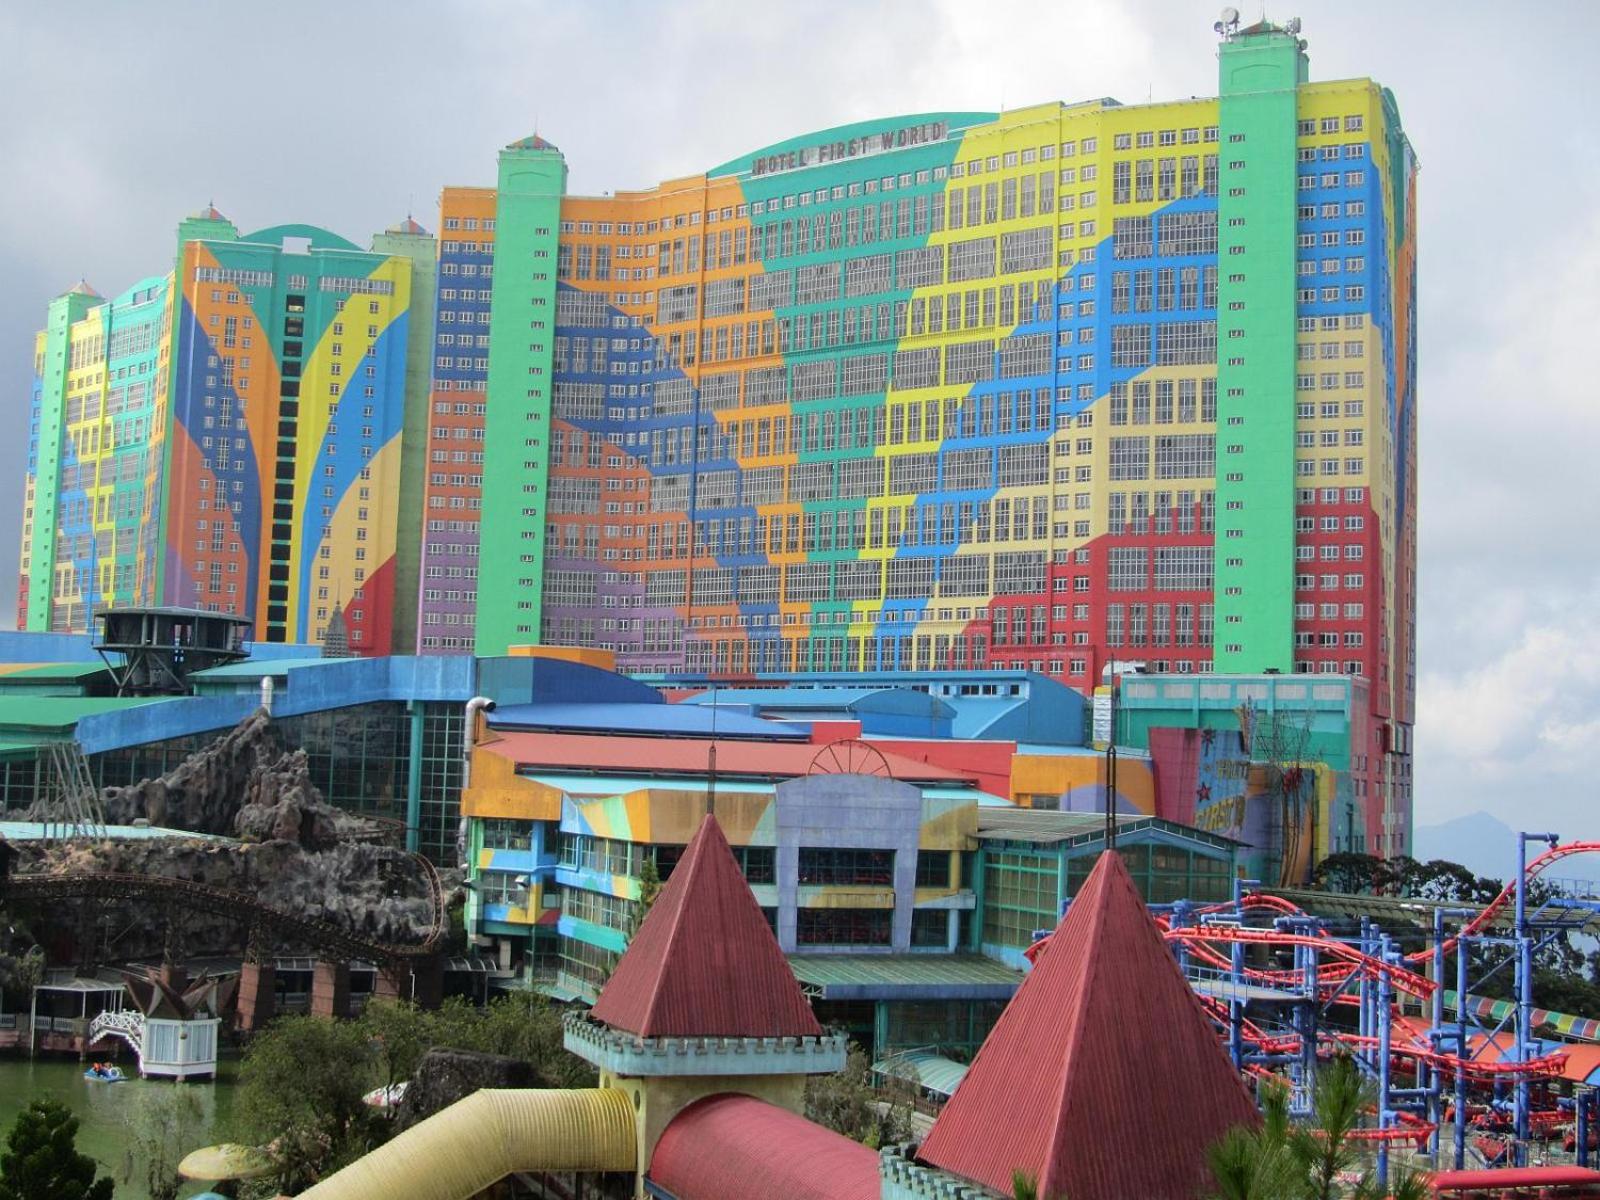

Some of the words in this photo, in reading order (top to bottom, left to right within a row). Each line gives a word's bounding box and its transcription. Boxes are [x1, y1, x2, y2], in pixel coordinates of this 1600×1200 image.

[756, 150, 807, 175] HOTEL
[819, 136, 869, 163] FIRST
[881, 121, 946, 150] WORLD
